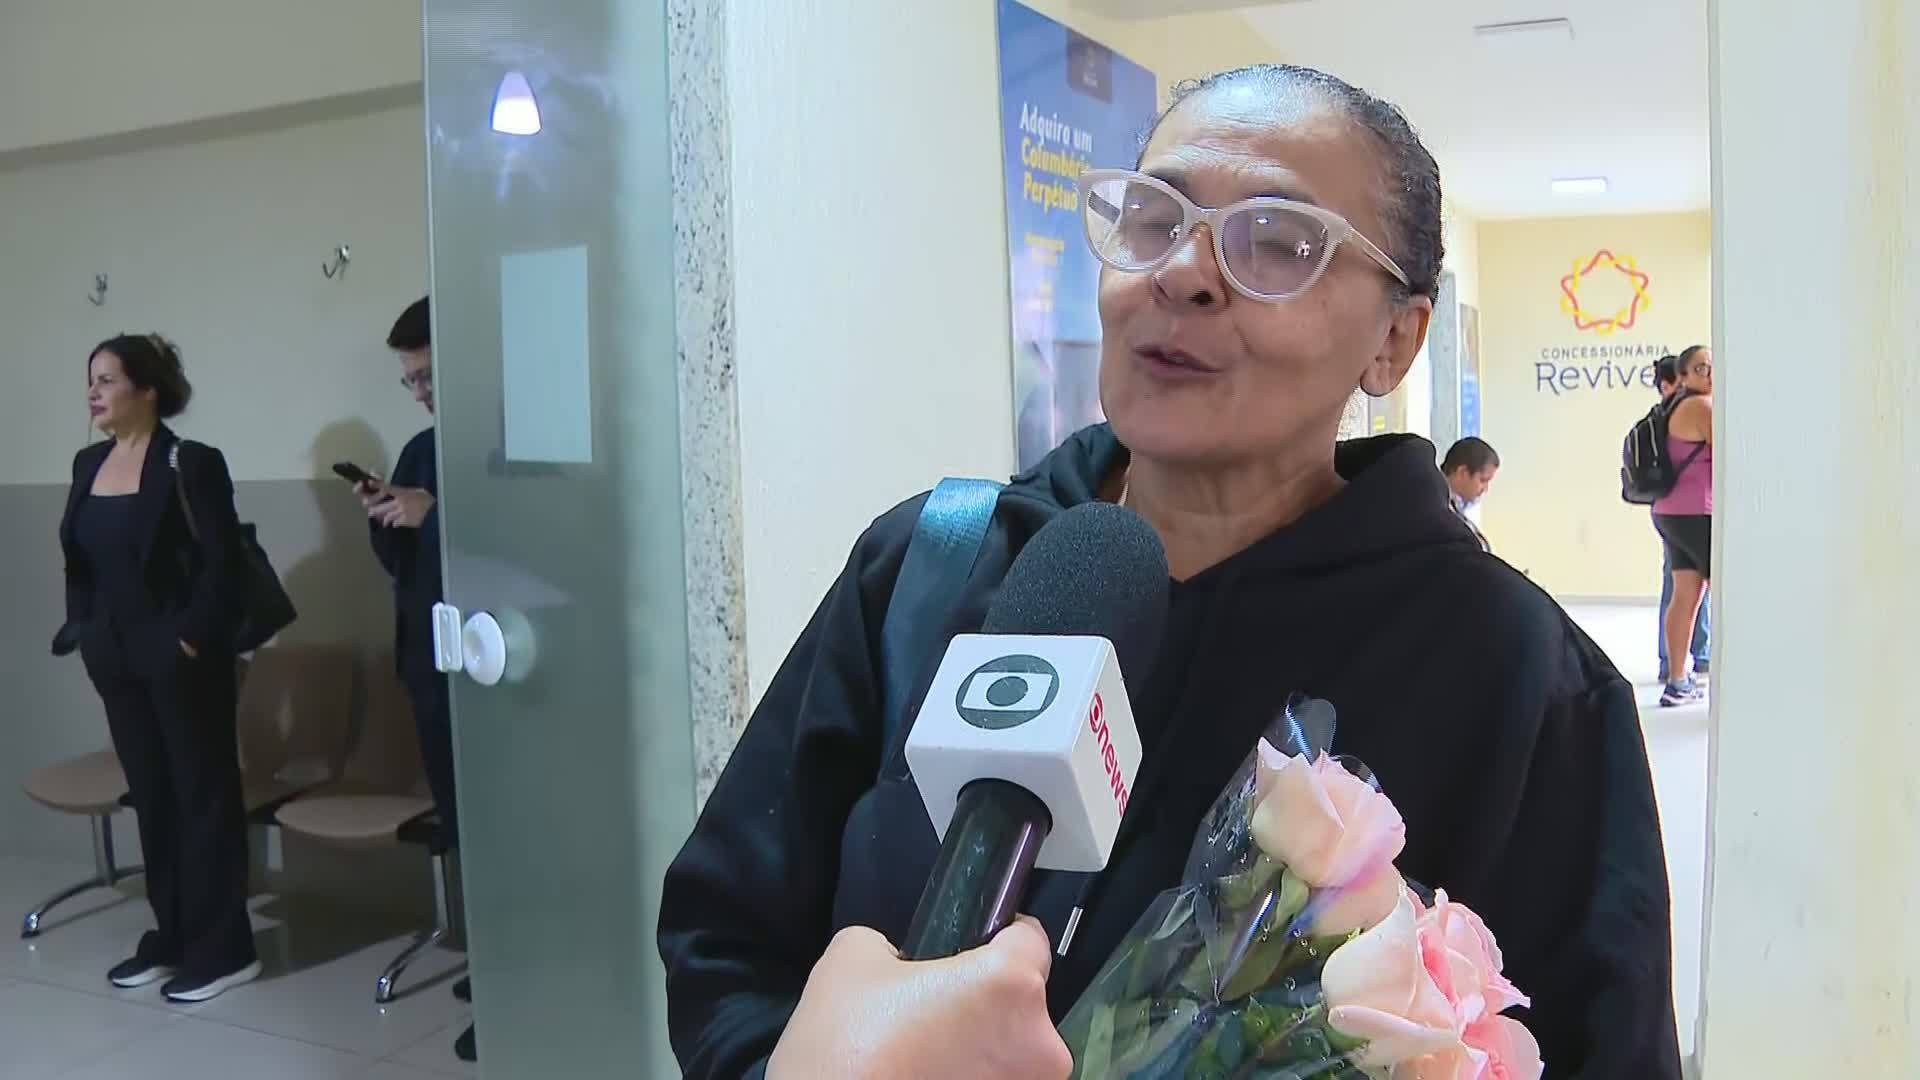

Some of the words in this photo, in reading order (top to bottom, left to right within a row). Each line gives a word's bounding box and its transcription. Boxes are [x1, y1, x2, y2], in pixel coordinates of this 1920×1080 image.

[1020, 101, 1070, 146] Adquira
[1073, 127, 1093, 153] um
[1541, 345, 1671, 360] CONCESSIONÁRIA
[1535, 360, 1657, 397] Revive
